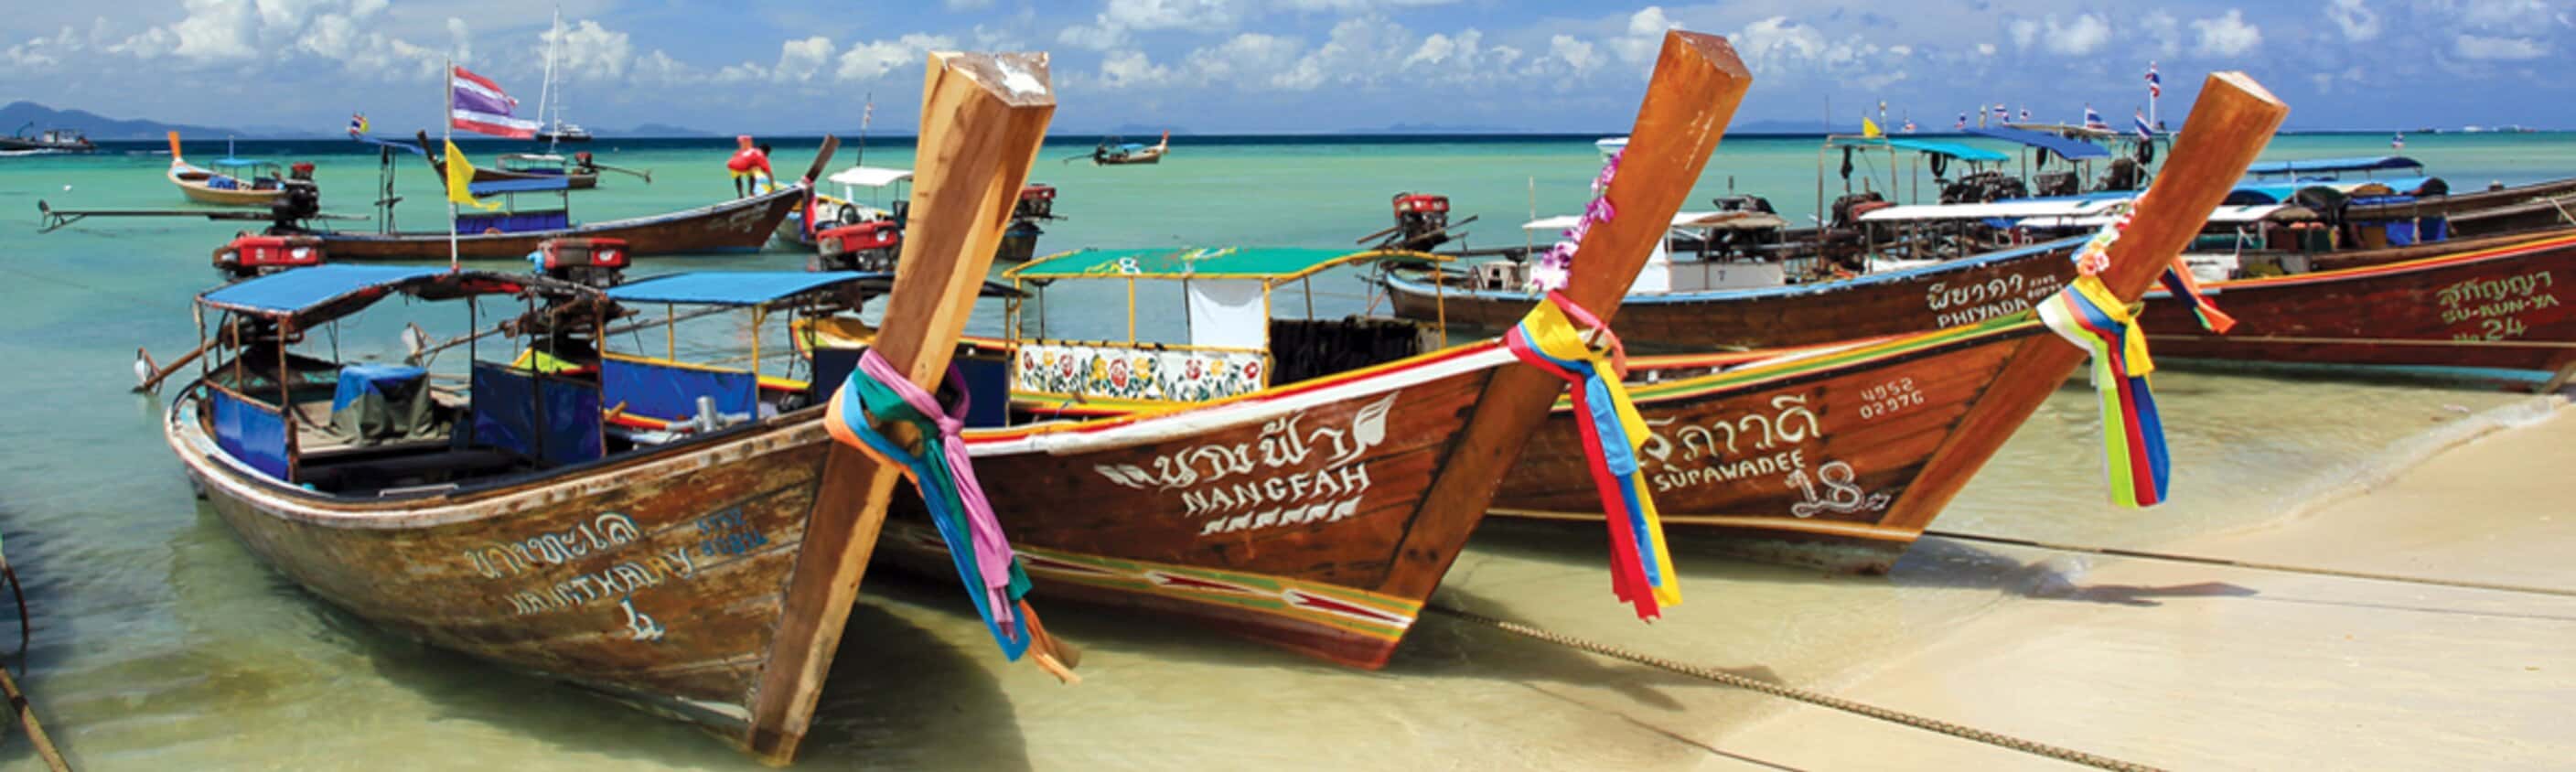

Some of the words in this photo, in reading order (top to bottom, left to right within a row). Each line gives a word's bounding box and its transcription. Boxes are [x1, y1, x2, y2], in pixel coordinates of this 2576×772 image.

[1936, 296, 2032, 330] PHIYADA
[2481, 316, 2528, 342] 24
[1151, 410, 1358, 488] นางฟ้า
[1653, 449, 1807, 492] SUPAWADEE
[1181, 462, 1371, 517] NANGFAH
